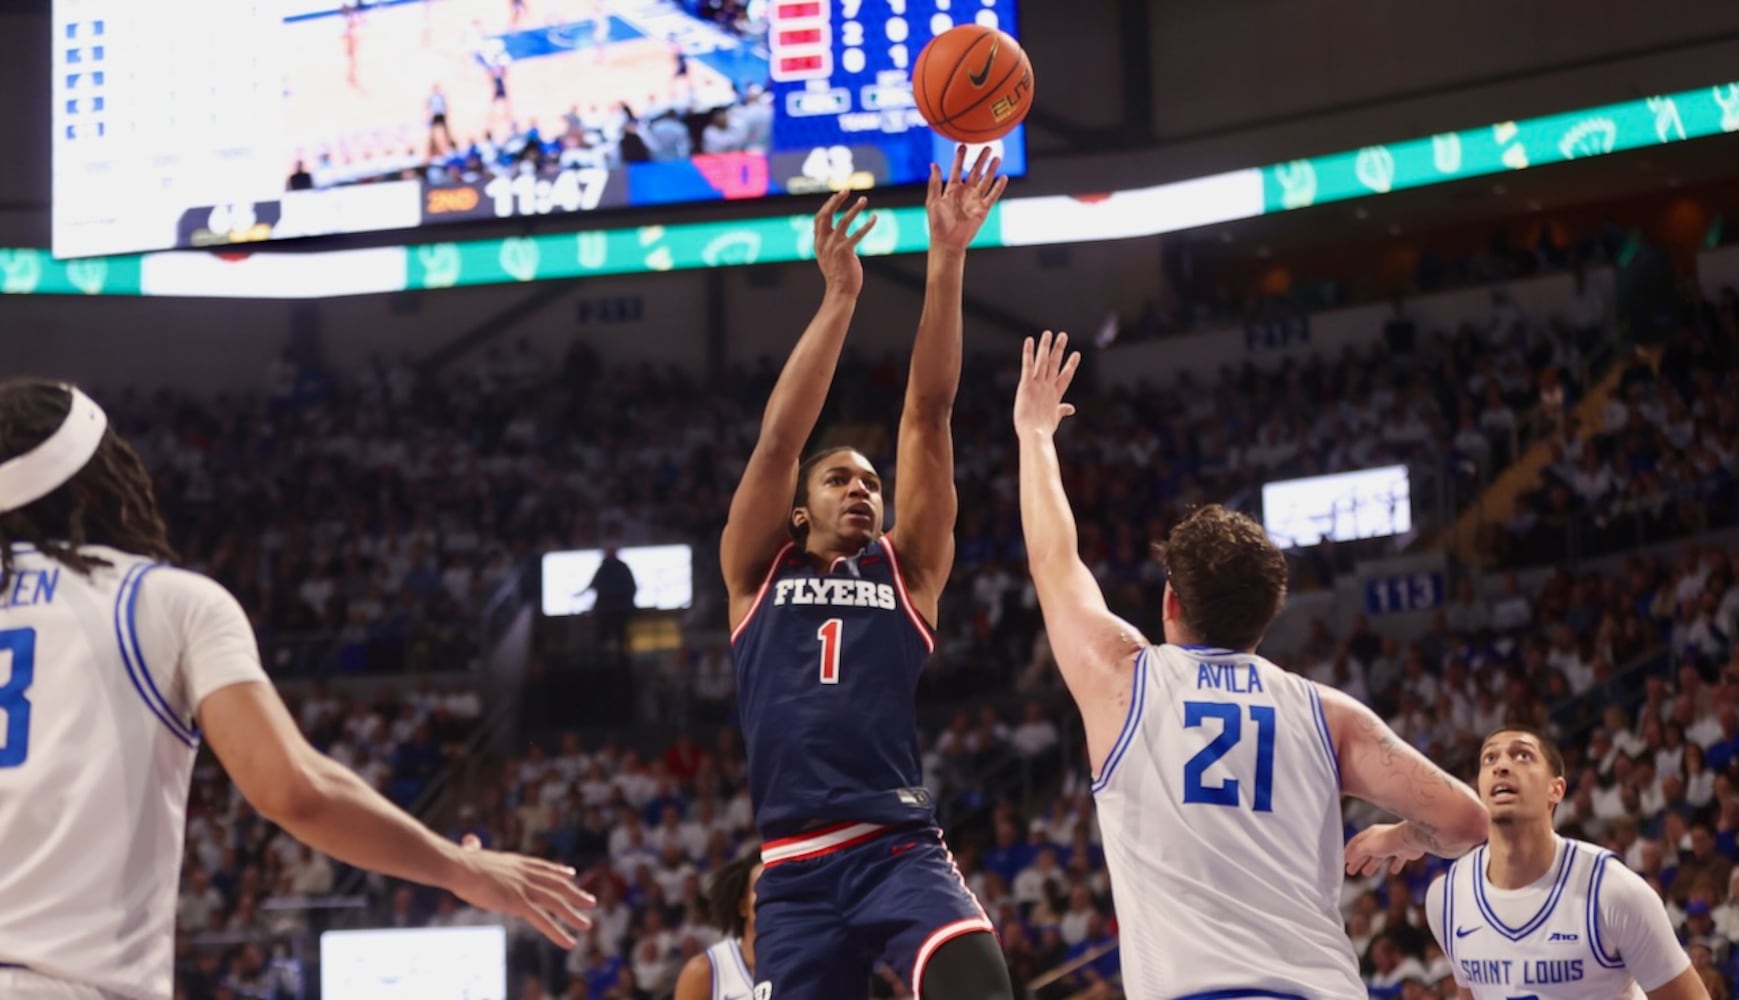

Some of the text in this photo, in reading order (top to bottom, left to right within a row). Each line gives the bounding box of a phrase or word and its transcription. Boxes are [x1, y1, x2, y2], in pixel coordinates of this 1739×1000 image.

[484, 168, 609, 217] 11:47
[773, 577, 897, 610] FLYERS
[1376, 574, 1436, 612] 113
[817, 618, 843, 684] 1
[1197, 662, 1264, 694] AVILA
[1183, 700, 1276, 813] 21
[1460, 959, 1584, 986] SAINT LOUIS
